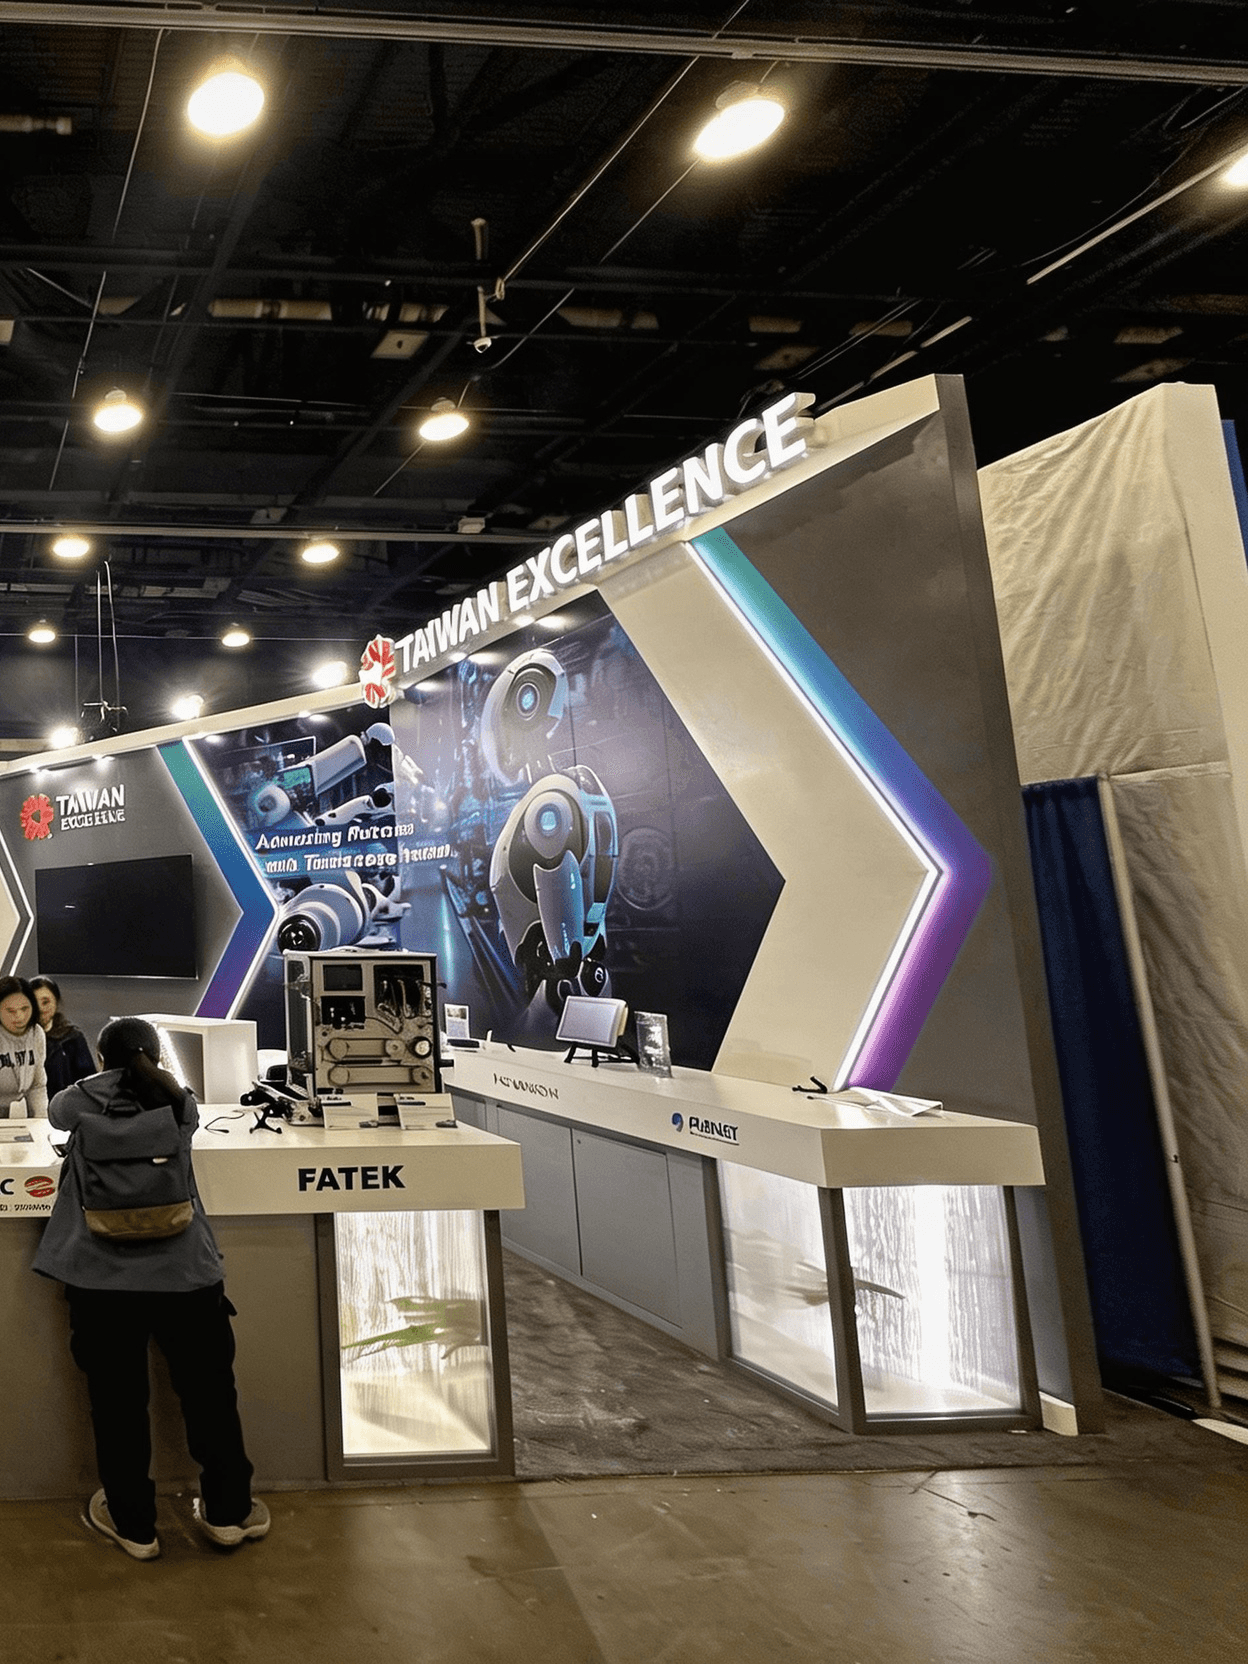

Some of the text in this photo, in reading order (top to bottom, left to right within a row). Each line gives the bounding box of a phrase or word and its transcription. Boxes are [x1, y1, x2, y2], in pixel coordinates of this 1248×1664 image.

[393, 392, 816, 674] TAIWAN EXCELLENCE
[298, 1165, 406, 1192] FATEK
